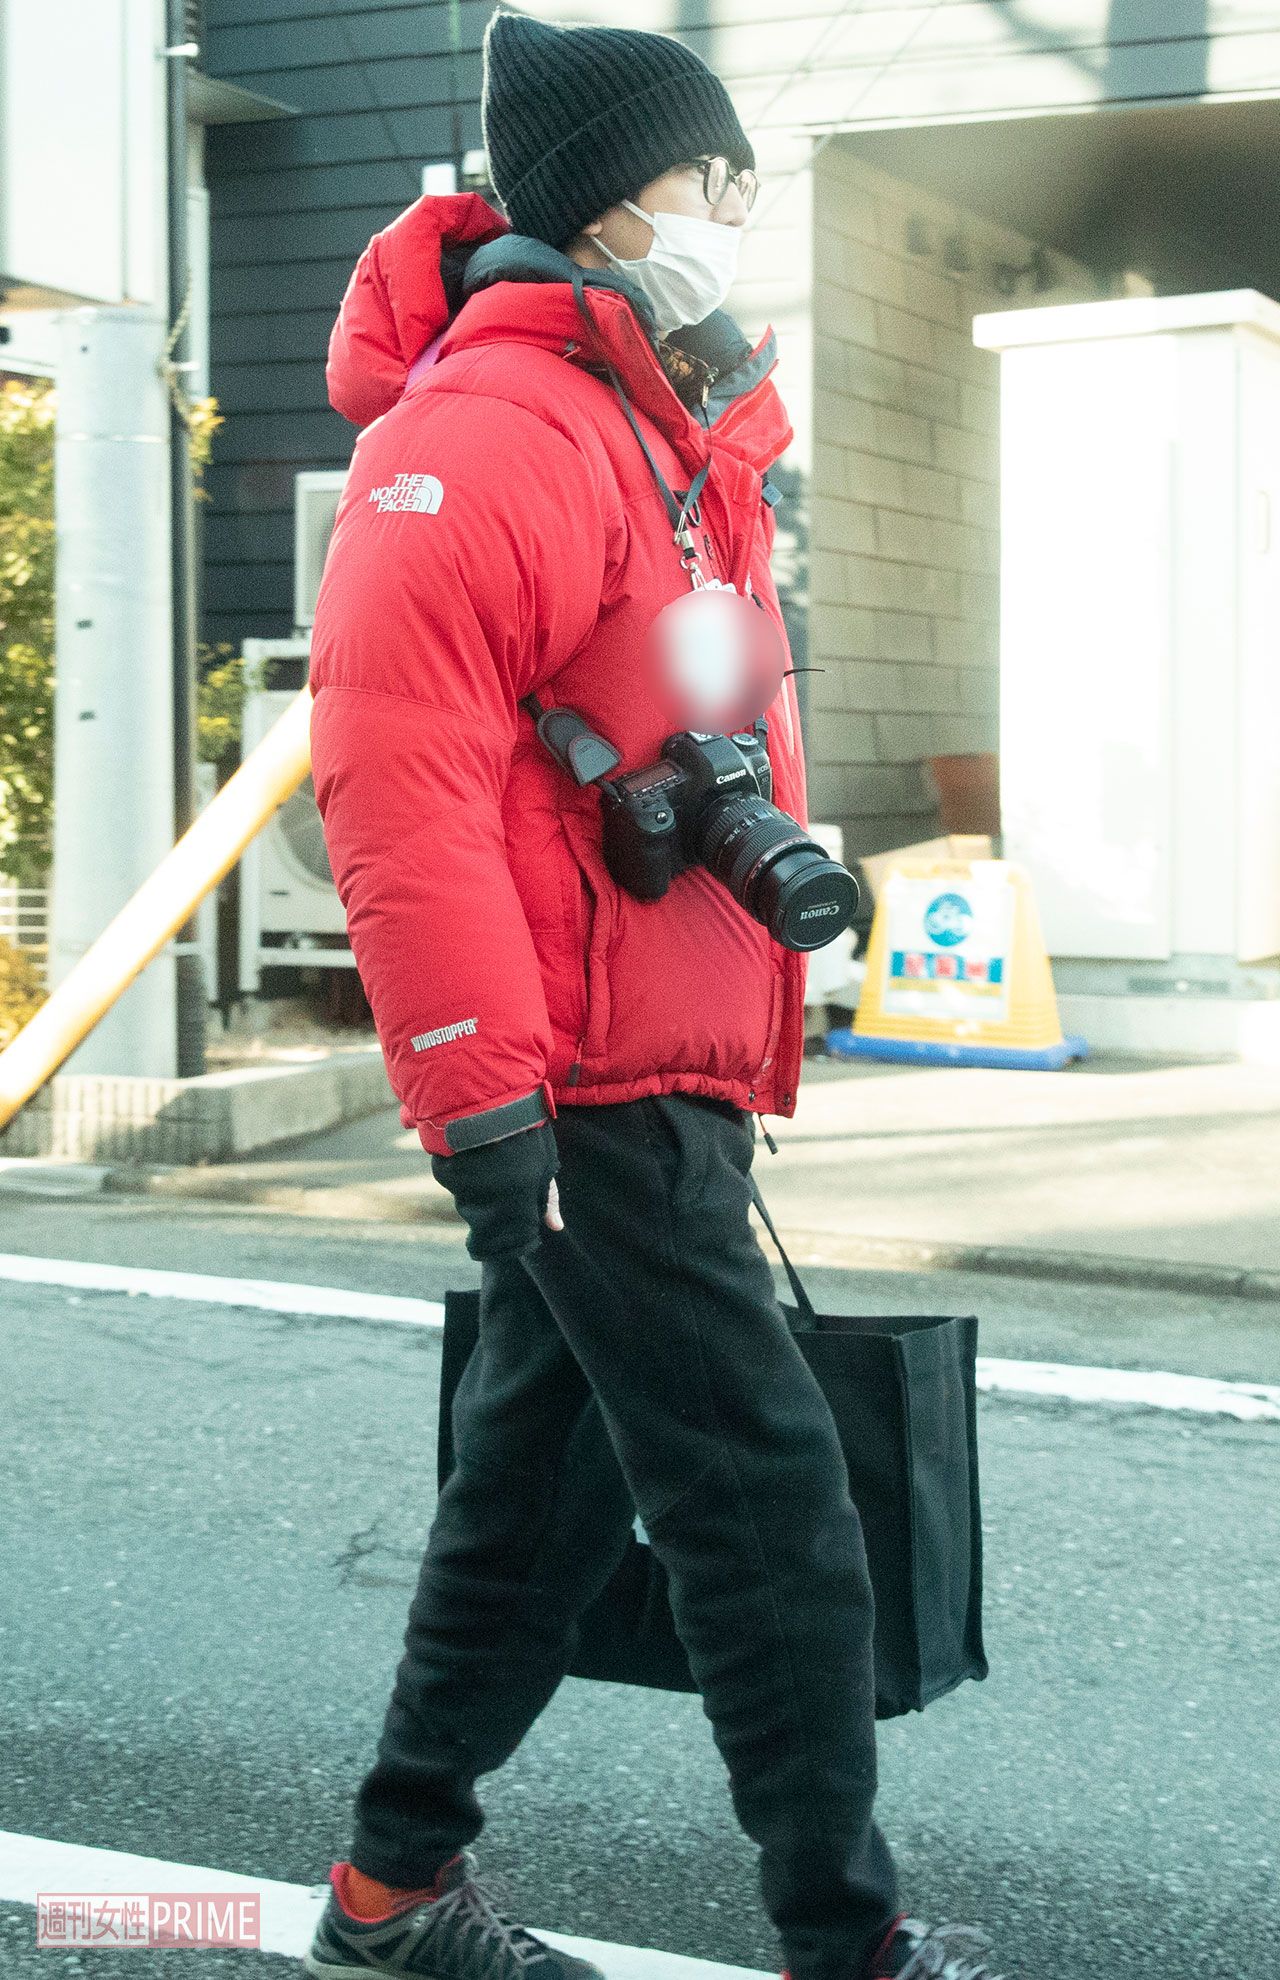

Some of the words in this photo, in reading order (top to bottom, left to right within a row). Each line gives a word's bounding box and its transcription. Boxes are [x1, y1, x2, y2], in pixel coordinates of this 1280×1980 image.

[394, 473, 424, 487] THE
[368, 486, 418, 503] NORTH
[376, 499, 415, 513] FACE
[716, 769, 746, 784] Canon
[800, 905, 839, 920] Canon
